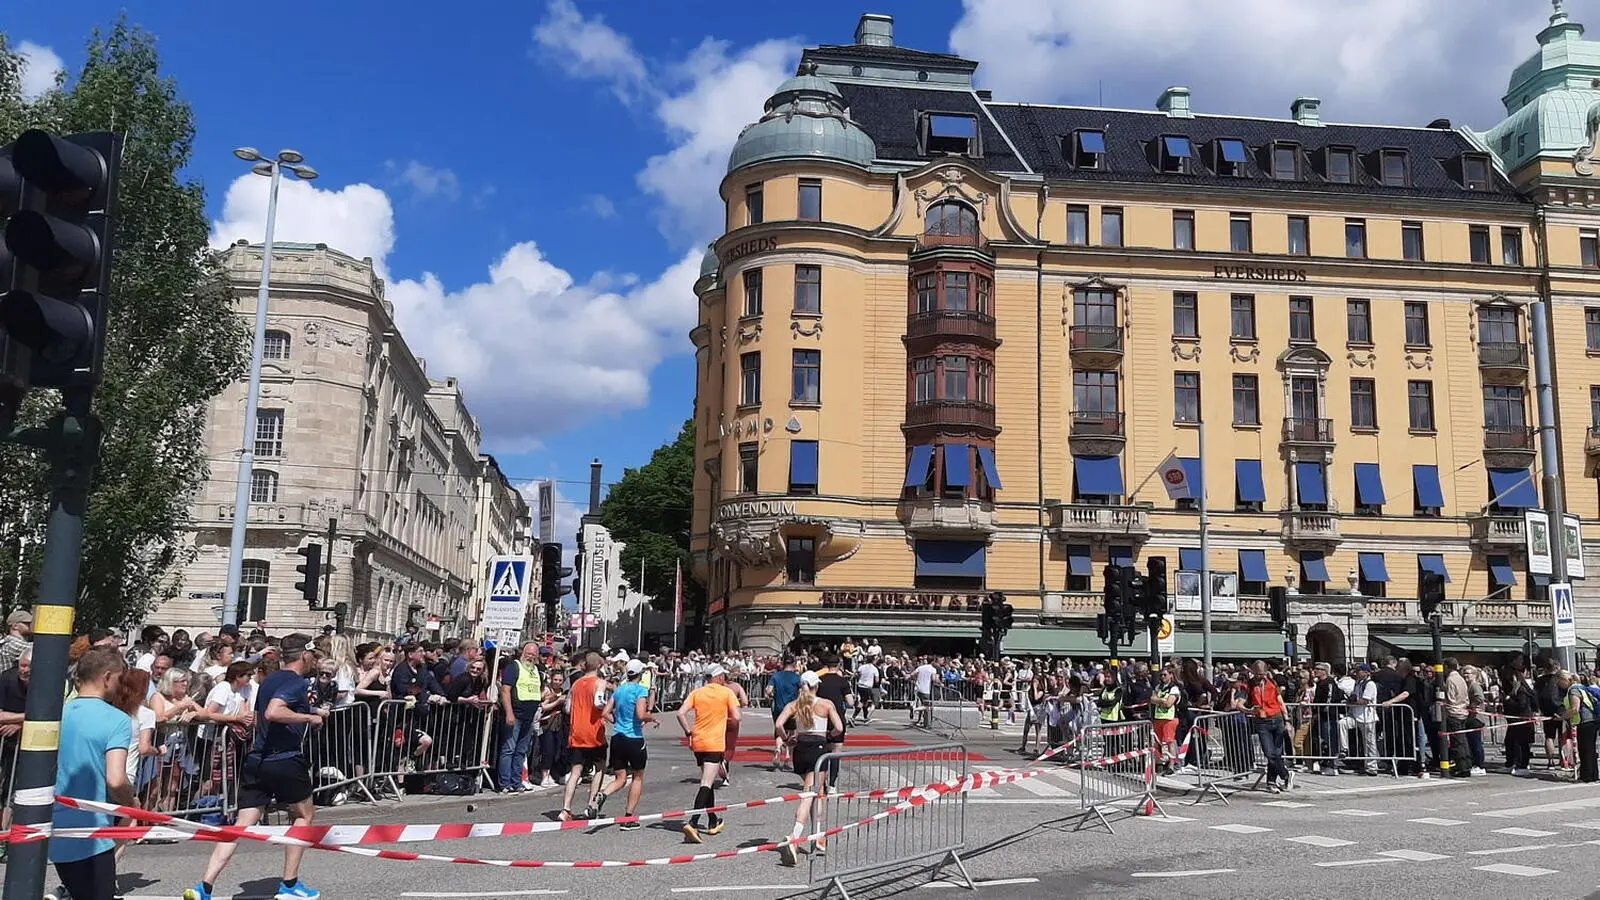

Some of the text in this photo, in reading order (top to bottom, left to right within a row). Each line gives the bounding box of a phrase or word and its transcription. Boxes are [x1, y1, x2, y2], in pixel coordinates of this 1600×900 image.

[1214, 265, 1307, 282] EVERSHEDS
[718, 501, 796, 518] ONVENDUM
[591, 531, 605, 619] ENKONSTMUSEET
[822, 590, 944, 609] RESTAURANT
[949, 593, 963, 609] &
